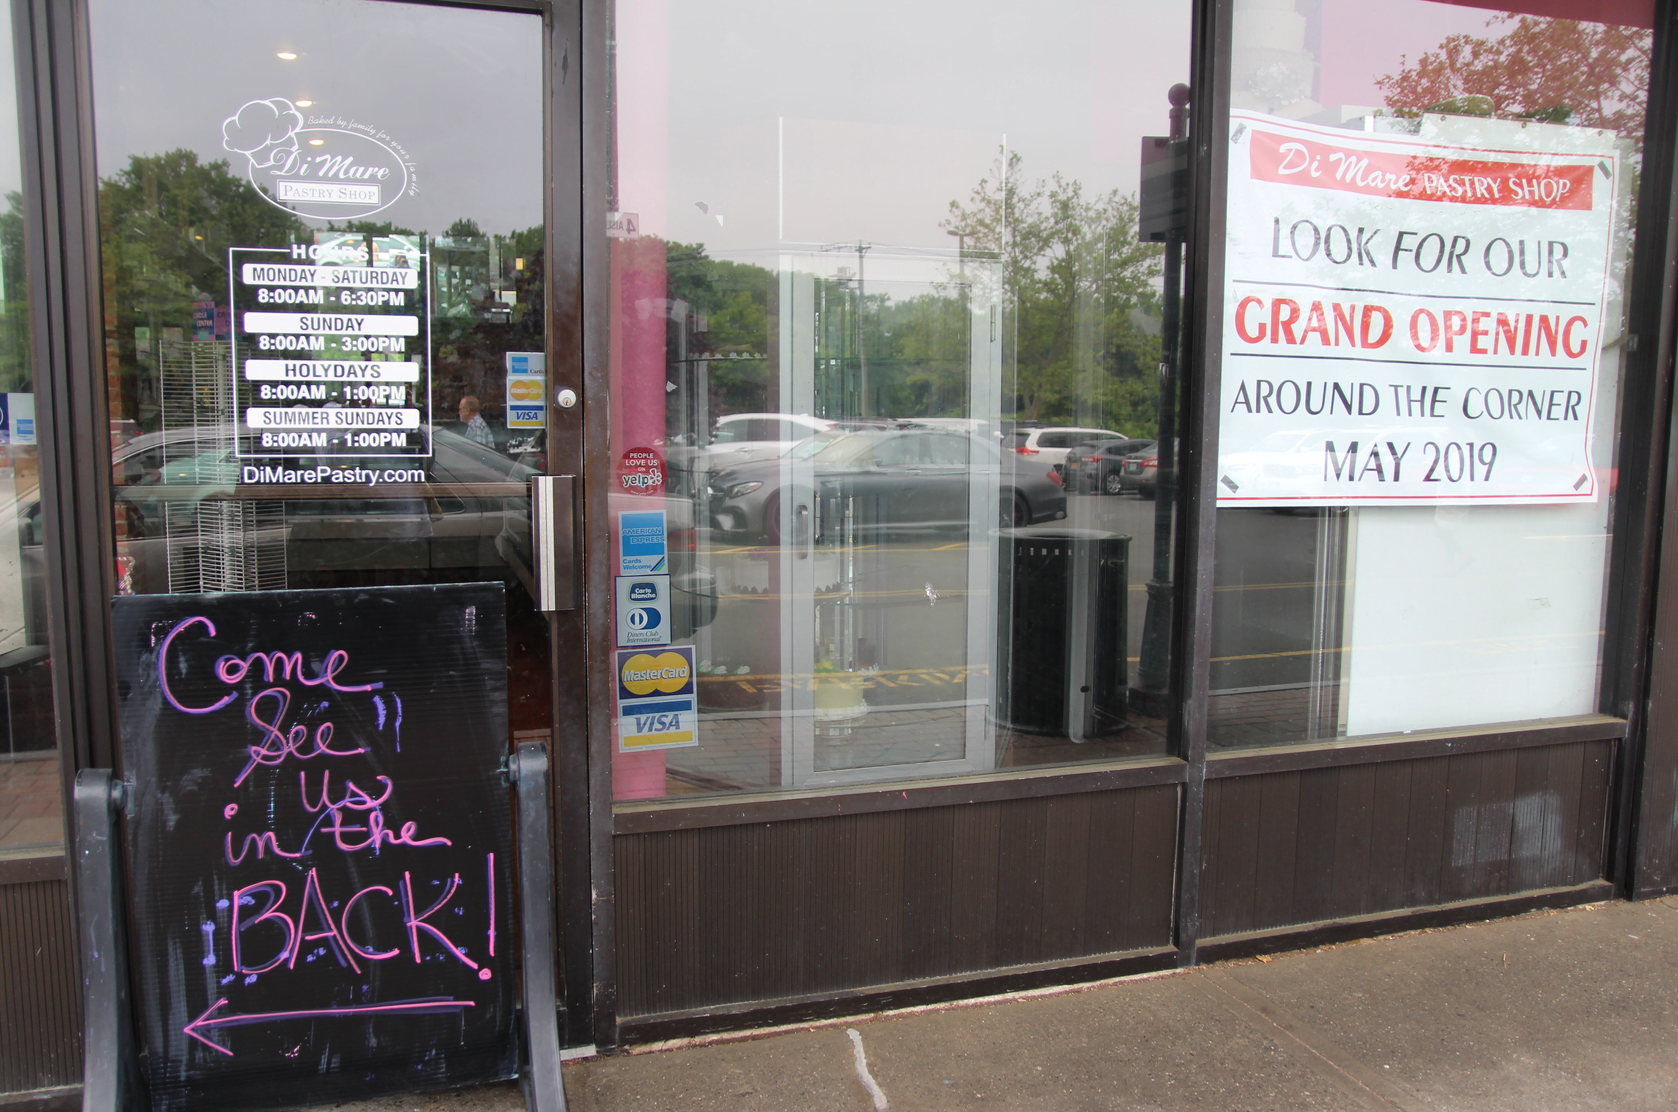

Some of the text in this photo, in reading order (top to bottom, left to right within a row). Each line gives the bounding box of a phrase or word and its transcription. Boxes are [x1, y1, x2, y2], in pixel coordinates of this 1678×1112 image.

[270, 147, 391, 181] Di Mare
[1277, 141, 1571, 202] Di Mare PASTRY SHOP
[283, 184, 376, 201] PASTRY SHOP
[292, 244, 369, 260] HOURS
[1271, 215, 1569, 279] LOOK FOR OUR
[252, 267, 317, 282] MONDAY
[331, 269, 408, 286] SATURDAY
[257, 288, 324, 304] 8:00AM
[340, 290, 405, 306] 6:30PM
[300, 316, 364, 331] SUNDAY
[1234, 295, 1589, 360] GRAND OPENING
[259, 335, 325, 351] 8:00AM
[341, 337, 405, 352] 3:00PM
[284, 363, 381, 378] HOLYDAYS
[260, 384, 326, 400] 8:00AM
[343, 385, 406, 400] 1:00PM
[1230, 379, 1582, 421] AROUND THE CORNER
[263, 411, 404, 426] SUMMER SUNDAYS
[516, 411, 538, 420] VISA
[262, 432, 327, 447] 8:00AM
[344, 432, 407, 447] 1:00PM
[1323, 440, 1498, 483] MAY 2019
[243, 466, 425, 487] DiMarePastry.com
[622, 472, 650, 488] yelp
[622, 526, 663, 536] AMERICAN
[630, 535, 665, 545] EXPRESS
[622, 563, 652, 571] Welcome
[158, 616, 384, 714] Come
[623, 666, 688, 683] MasterCard
[634, 713, 680, 733] VISA
[233, 686, 371, 788] See
[300, 768, 393, 813] us
[224, 802, 452, 866] in the
[232, 853, 495, 980] BACK!
